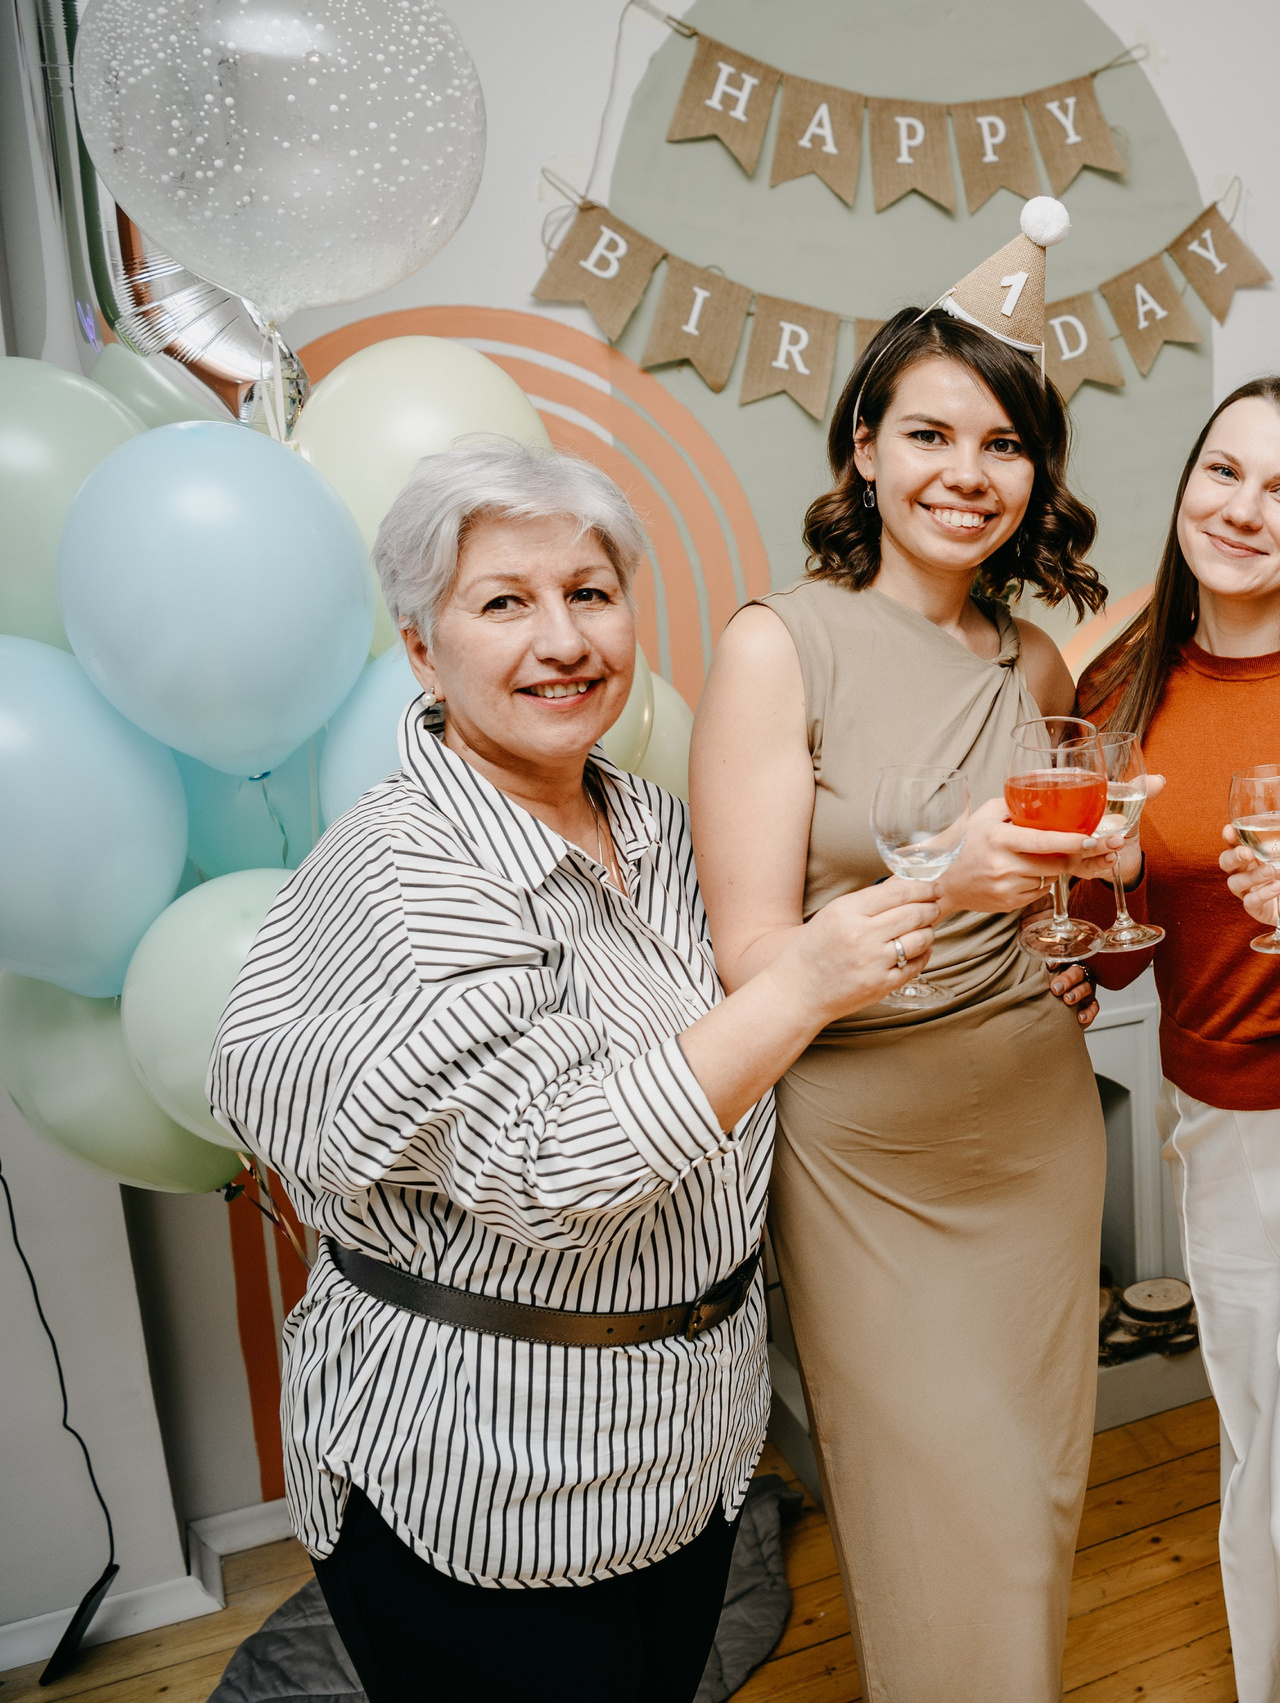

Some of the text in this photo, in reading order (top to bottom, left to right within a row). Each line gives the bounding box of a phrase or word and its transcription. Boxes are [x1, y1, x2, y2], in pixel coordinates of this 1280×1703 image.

[705, 61, 1083, 164] HAPPY
[579, 225, 1227, 376] BIRDAY
[1000, 271, 1029, 317] 1
